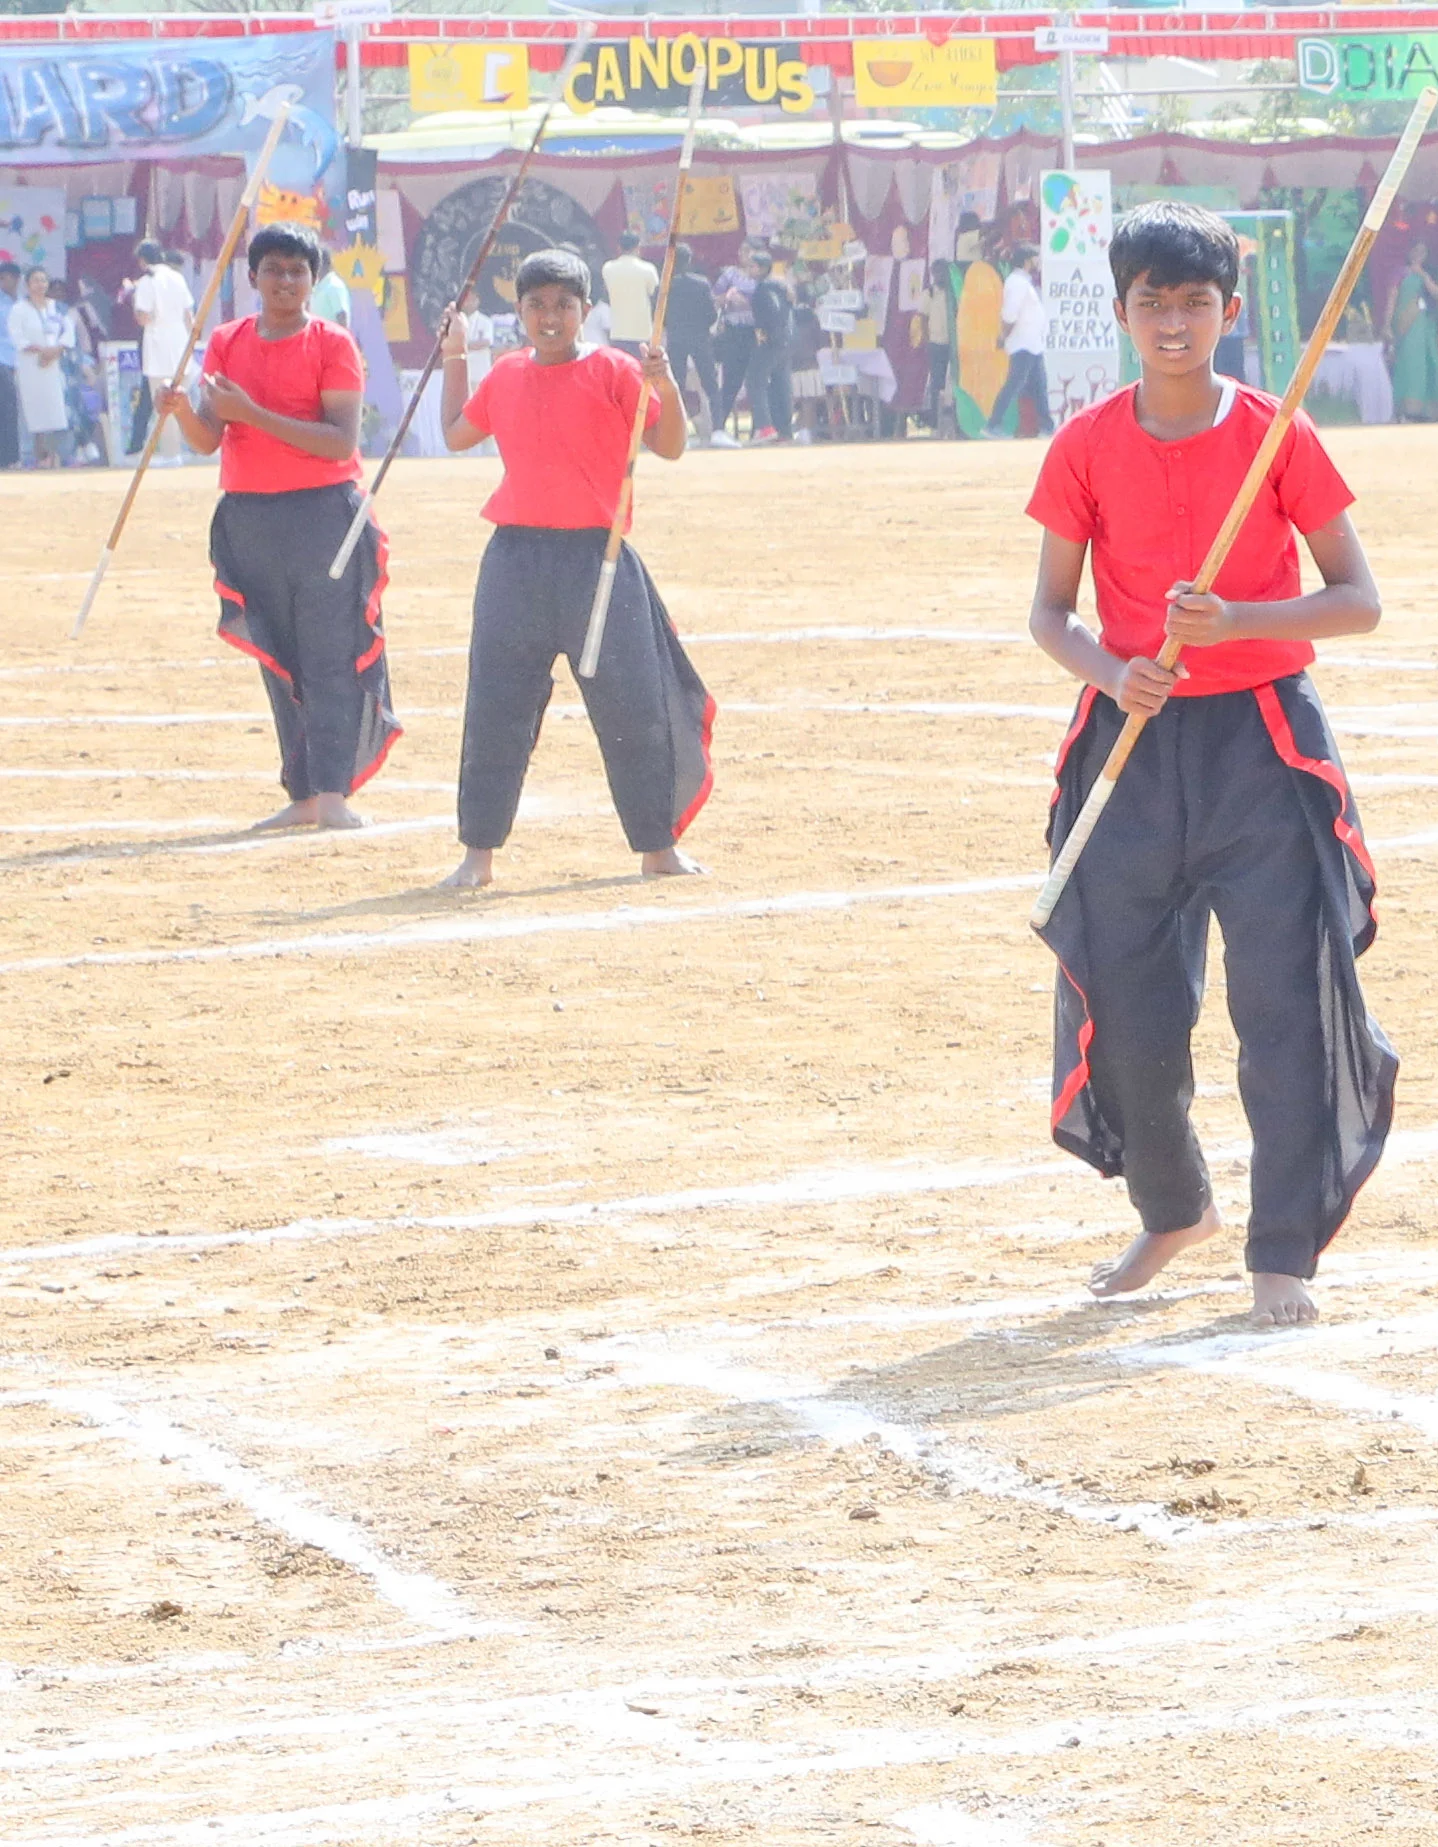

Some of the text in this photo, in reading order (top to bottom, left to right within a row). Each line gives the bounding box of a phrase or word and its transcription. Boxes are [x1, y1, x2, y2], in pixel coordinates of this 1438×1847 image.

[562, 33, 815, 114] CANOPUS
[1070, 267, 1083, 283] A
[1048, 281, 1106, 298] BREAD
[1059, 300, 1100, 317] FOR
[1048, 319, 1112, 336] EVERY
[1045, 334, 1116, 350] BREATH
